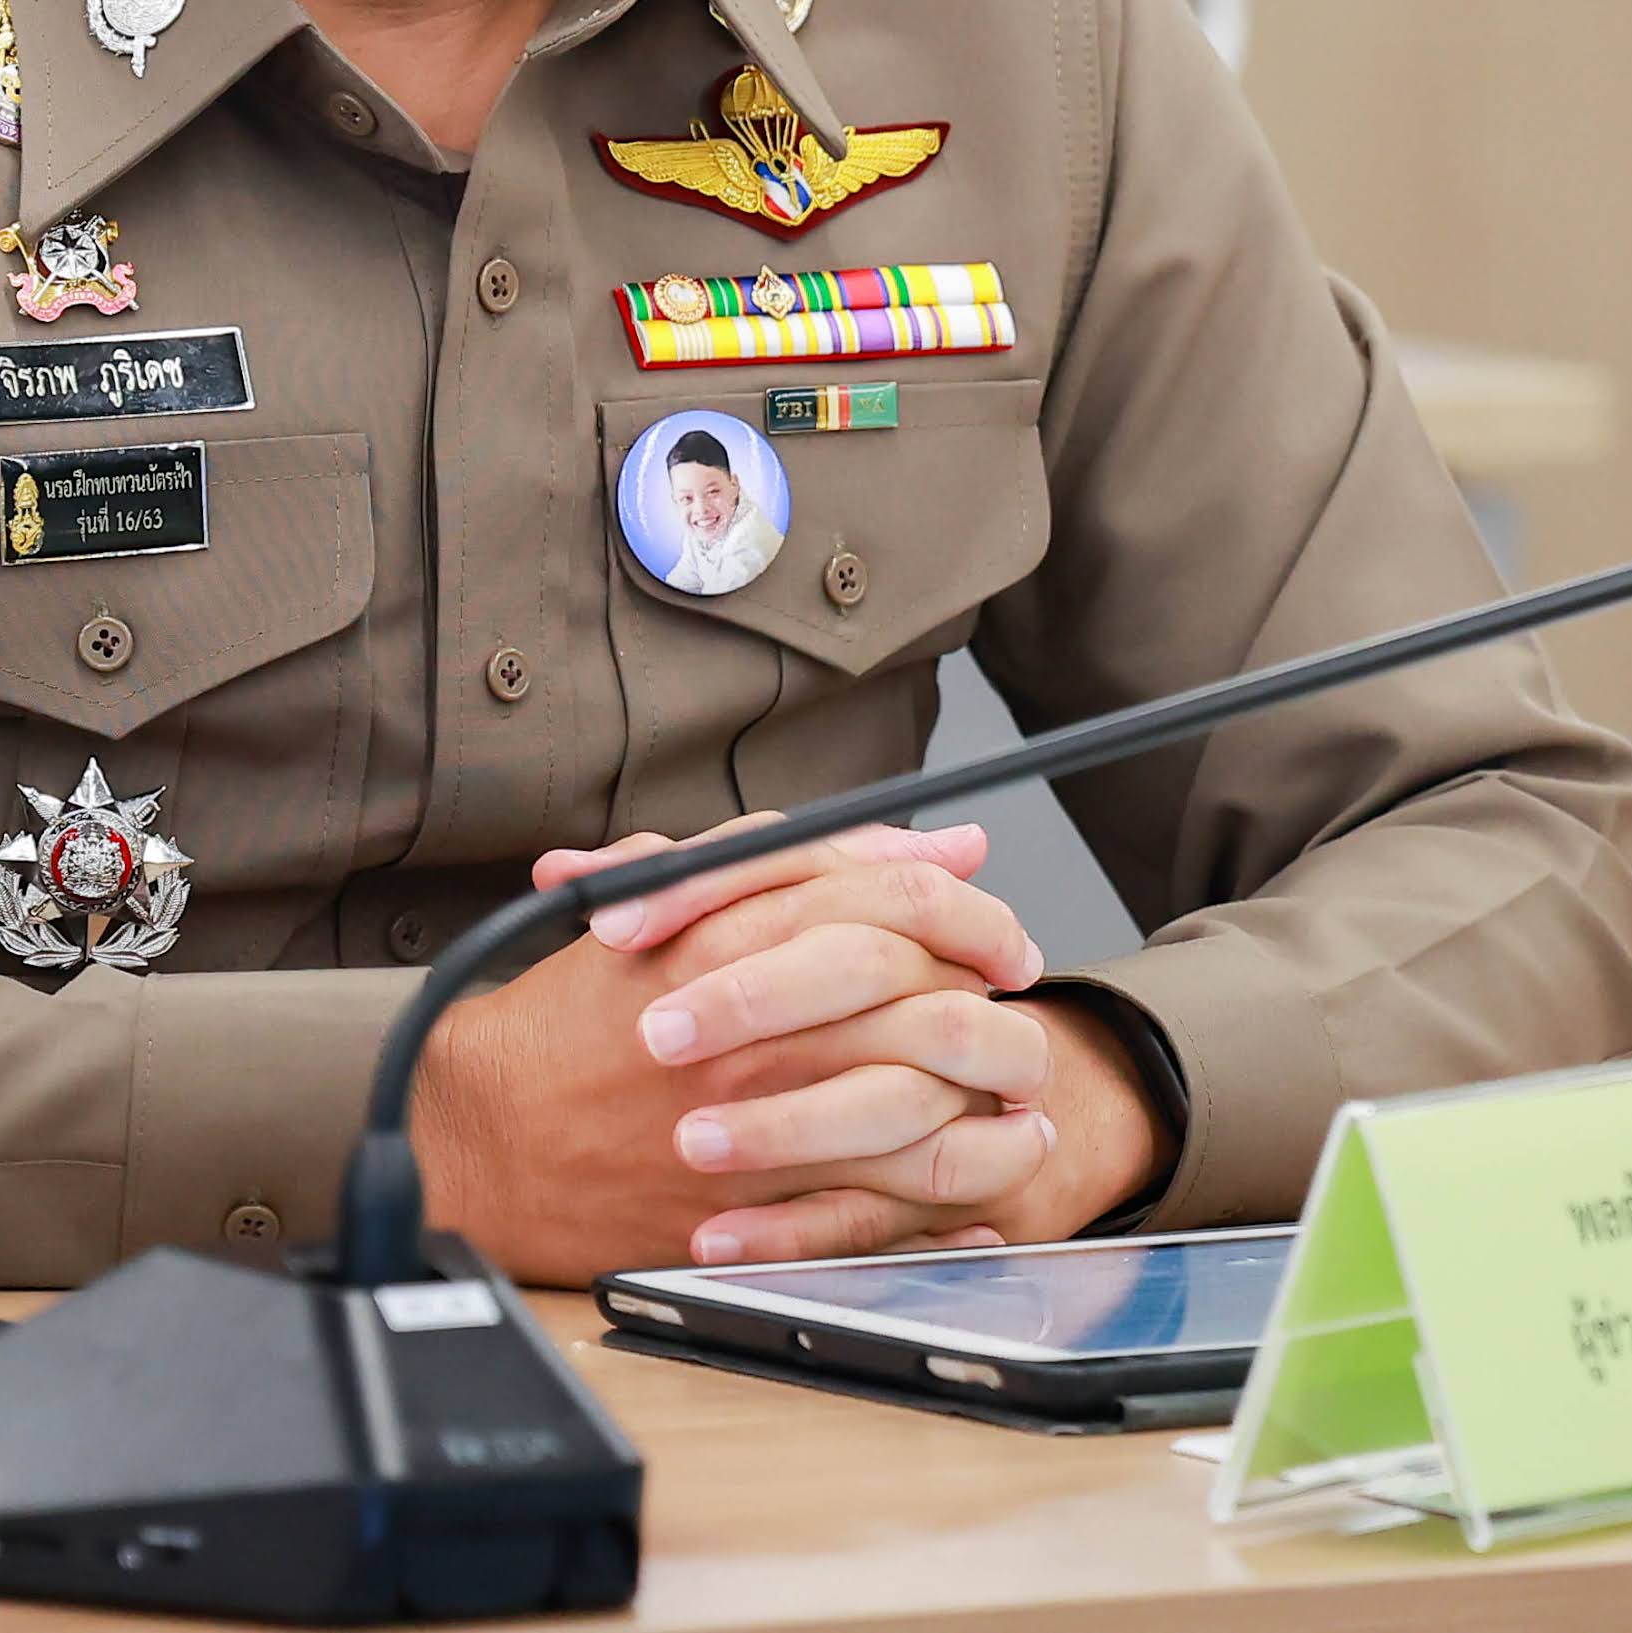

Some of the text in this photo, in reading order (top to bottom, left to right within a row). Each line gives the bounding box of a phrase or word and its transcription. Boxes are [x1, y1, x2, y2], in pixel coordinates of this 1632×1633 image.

[100, 348, 184, 408] ภูริเดช
[775, 401, 814, 419] FBI
[77, 501, 164, 543] รุ่นที่ 16/63
